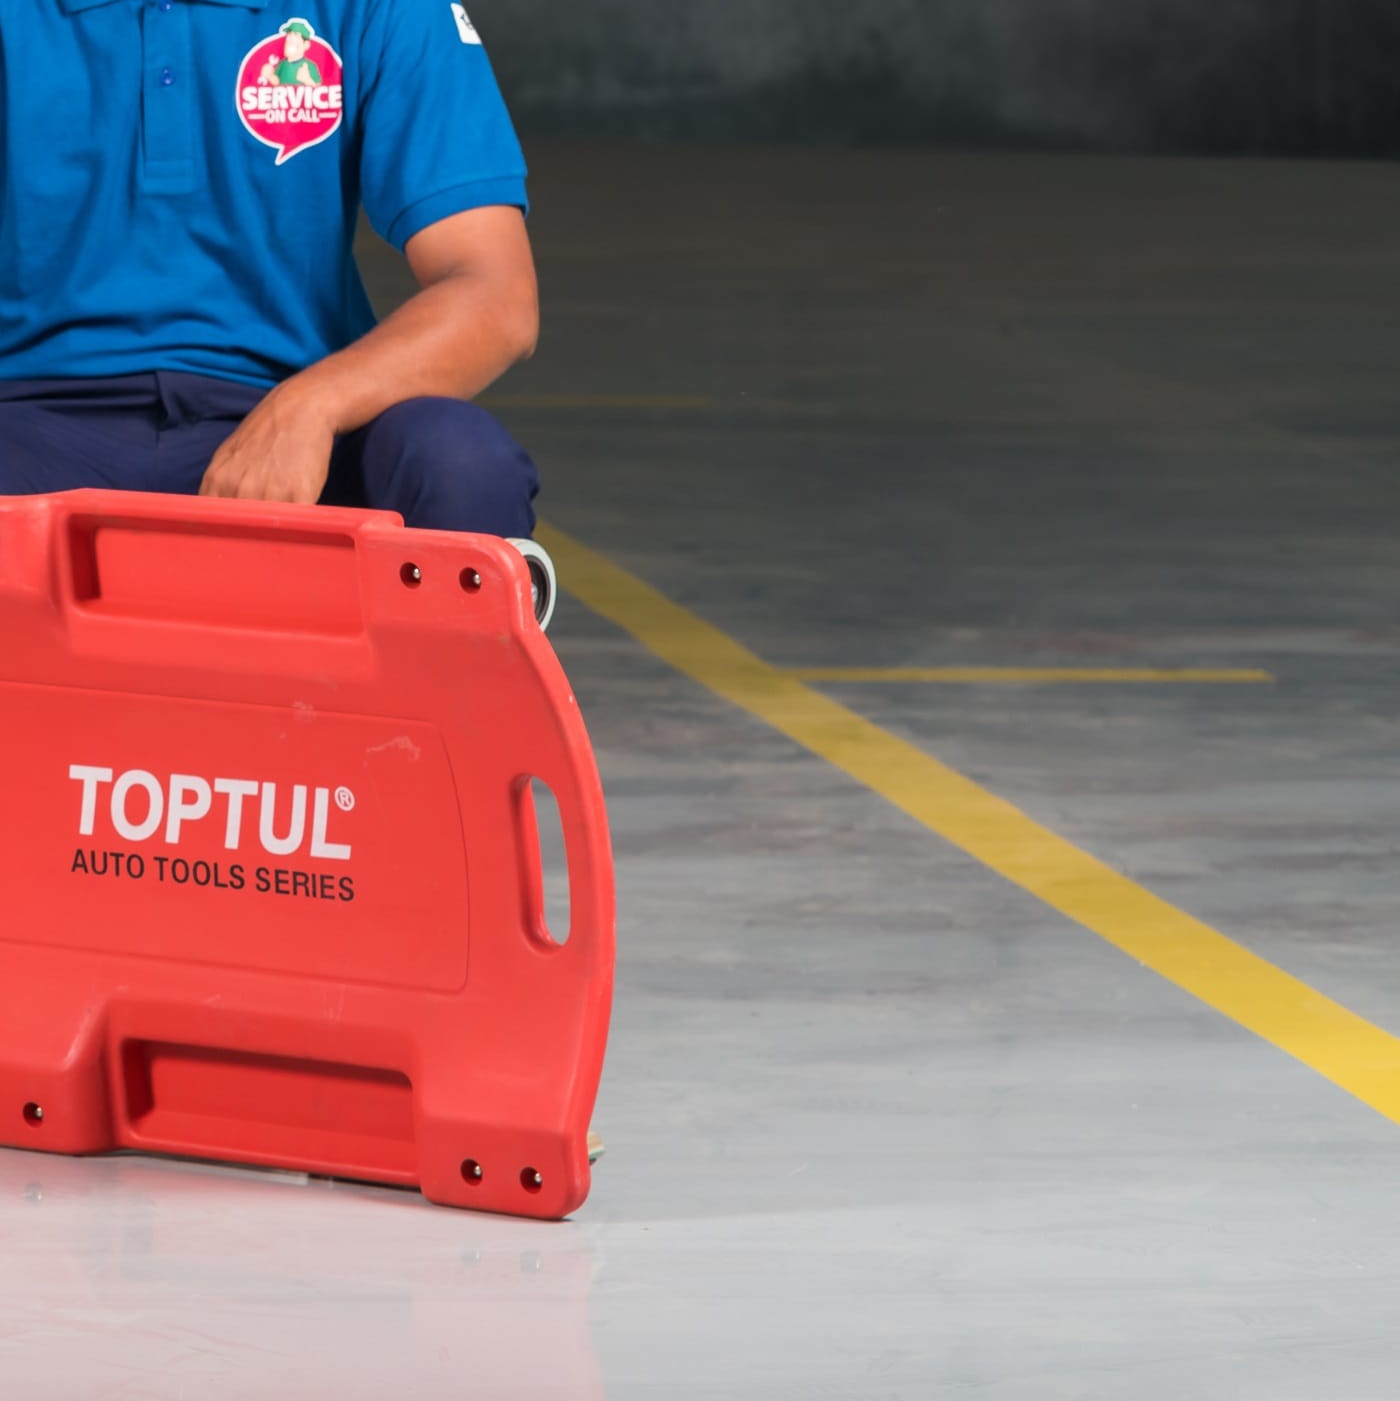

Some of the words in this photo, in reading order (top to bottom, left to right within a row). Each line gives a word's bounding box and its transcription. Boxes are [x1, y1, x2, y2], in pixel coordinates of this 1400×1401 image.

[242, 85, 342, 111] SERVICE
[265, 109, 286, 124] ON
[287, 108, 320, 123] CALL
[71, 848, 145, 879] AUTO
[153, 856, 245, 890] TOOLS
[255, 867, 355, 902] SERIES
